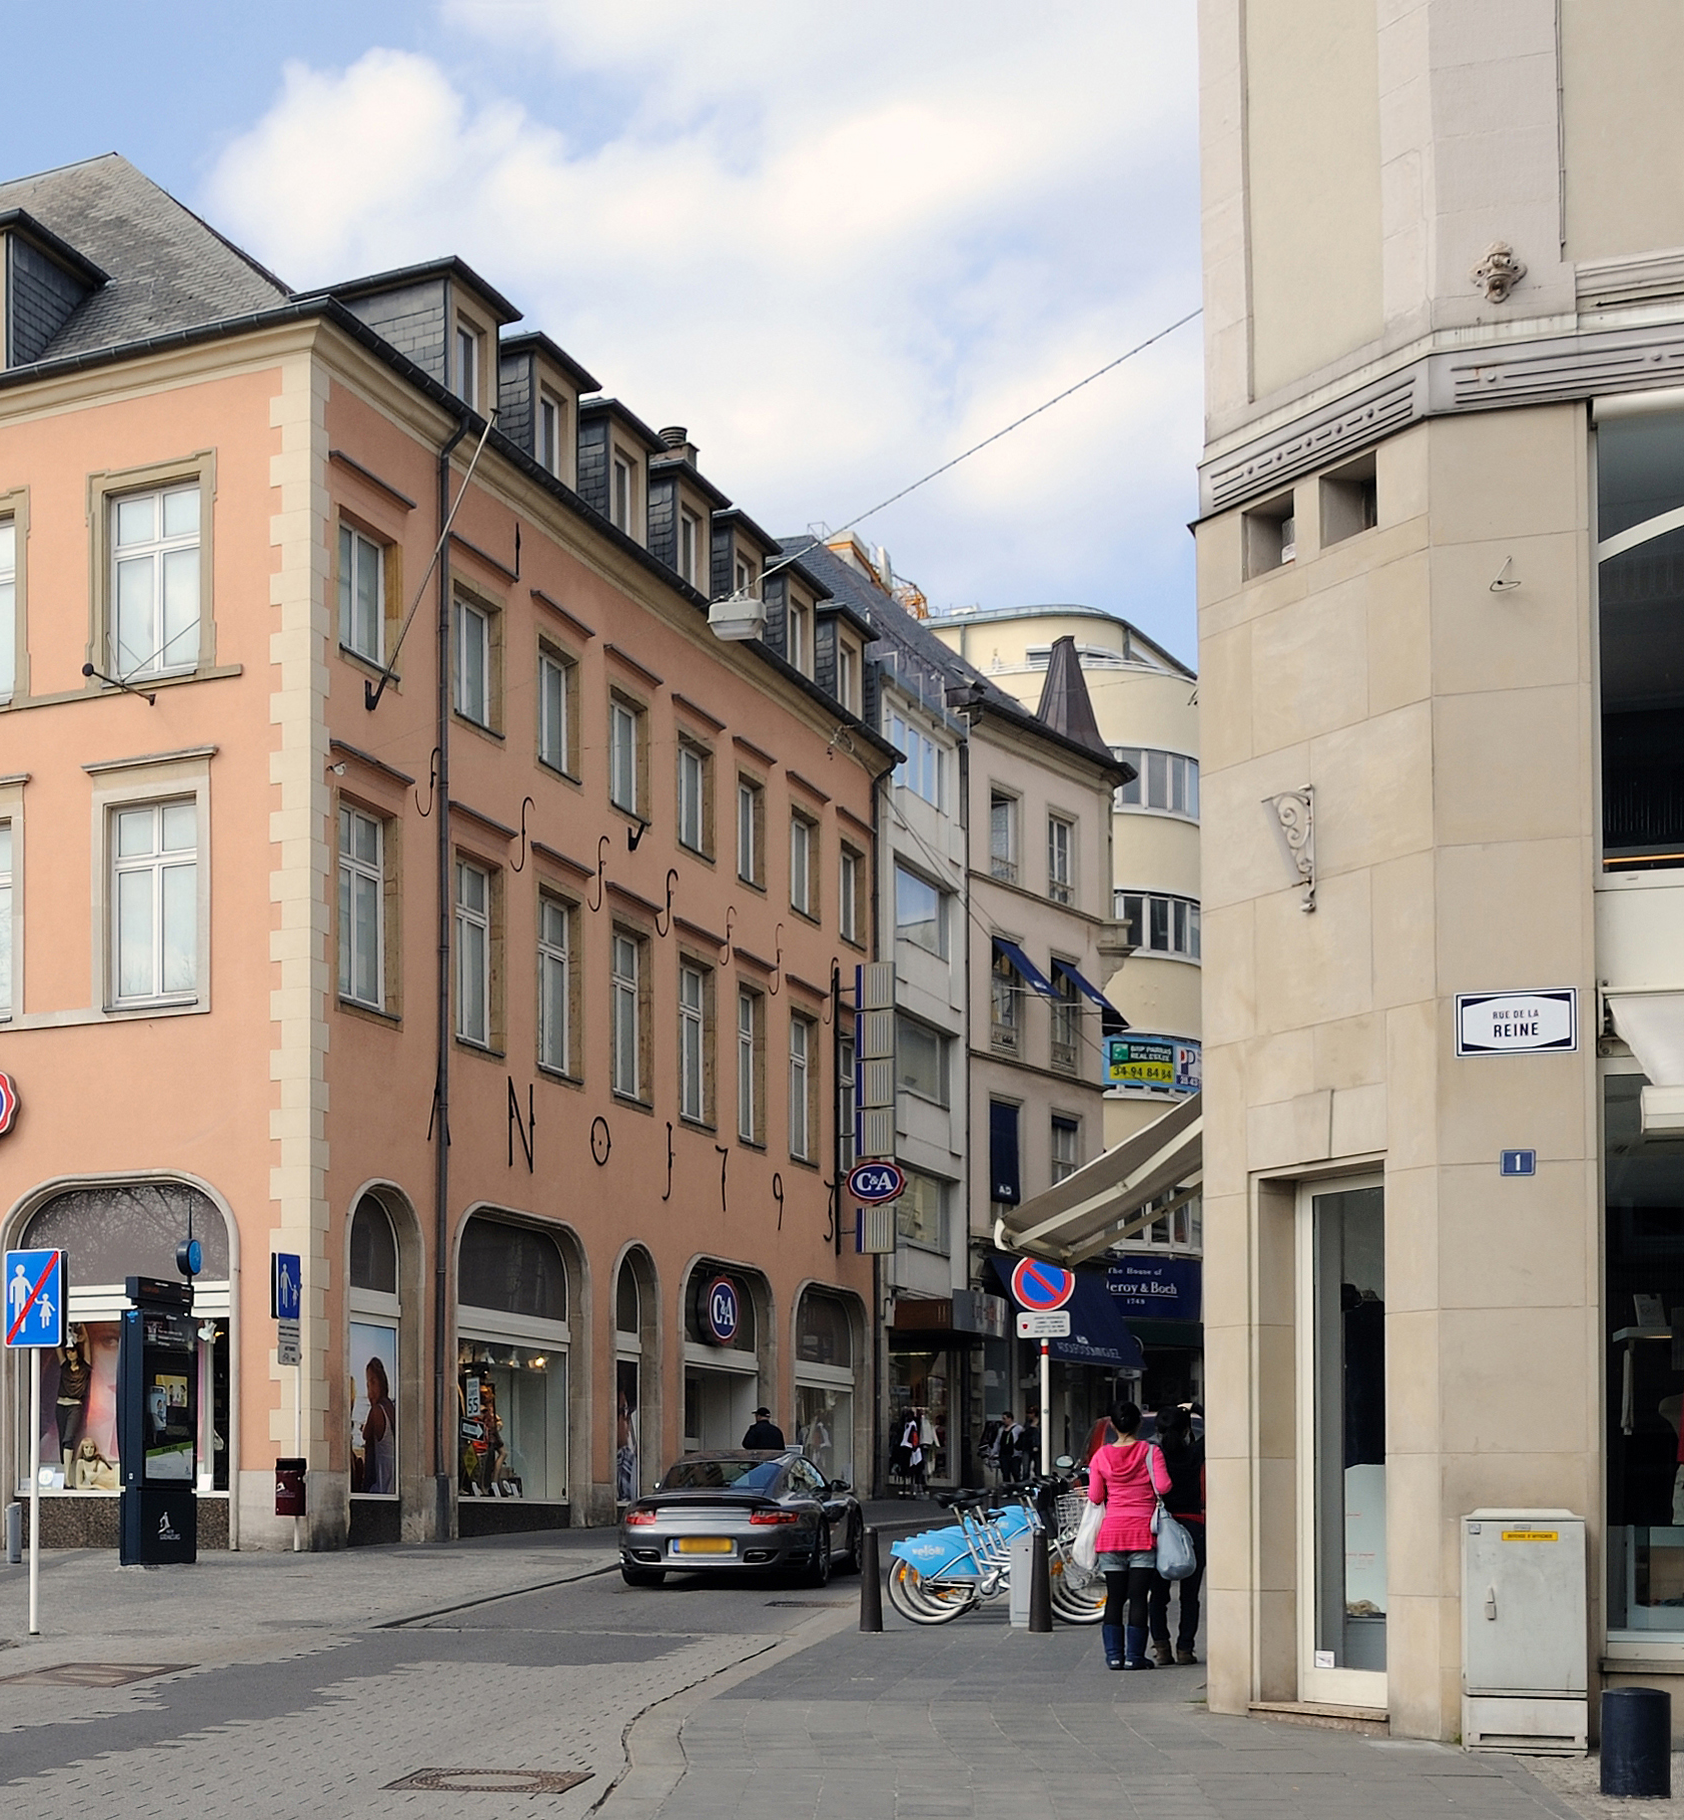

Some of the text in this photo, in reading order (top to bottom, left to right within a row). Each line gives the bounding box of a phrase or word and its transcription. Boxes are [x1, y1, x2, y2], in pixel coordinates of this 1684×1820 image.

[1492, 1009, 1539, 1020] RUE DE LA
[1493, 1022, 1539, 1038] REINE
[1515, 1153, 1521, 1171] 1
[856, 1171, 894, 1192] C&A
[1108, 1267, 1163, 1276] The House of
[1140, 1282, 1149, 1293] &
[1151, 1281, 1178, 1295] Boch
[713, 1294, 735, 1326] C&A
[468, 1397, 479, 1414] 55
